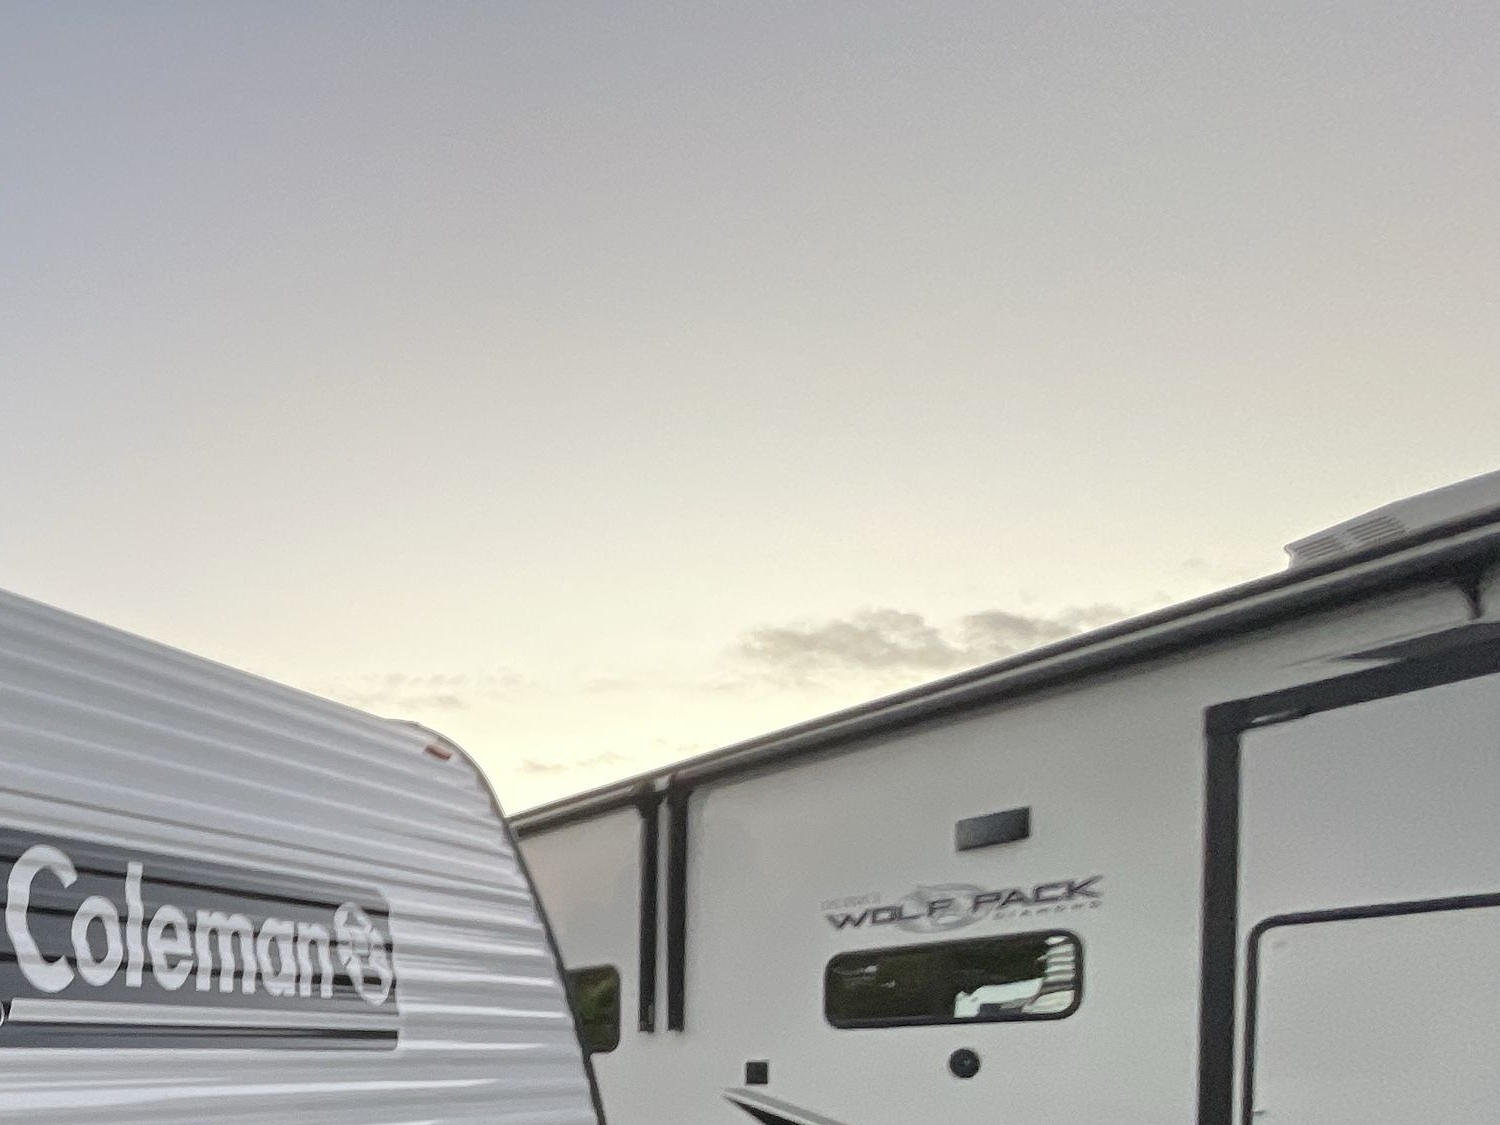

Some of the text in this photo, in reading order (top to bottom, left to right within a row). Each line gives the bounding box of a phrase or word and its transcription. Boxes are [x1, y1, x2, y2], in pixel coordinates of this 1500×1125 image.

[4, 843, 335, 999] Coleman
[826, 897, 956, 931] WOLF
[970, 874, 1104, 914] PACK
